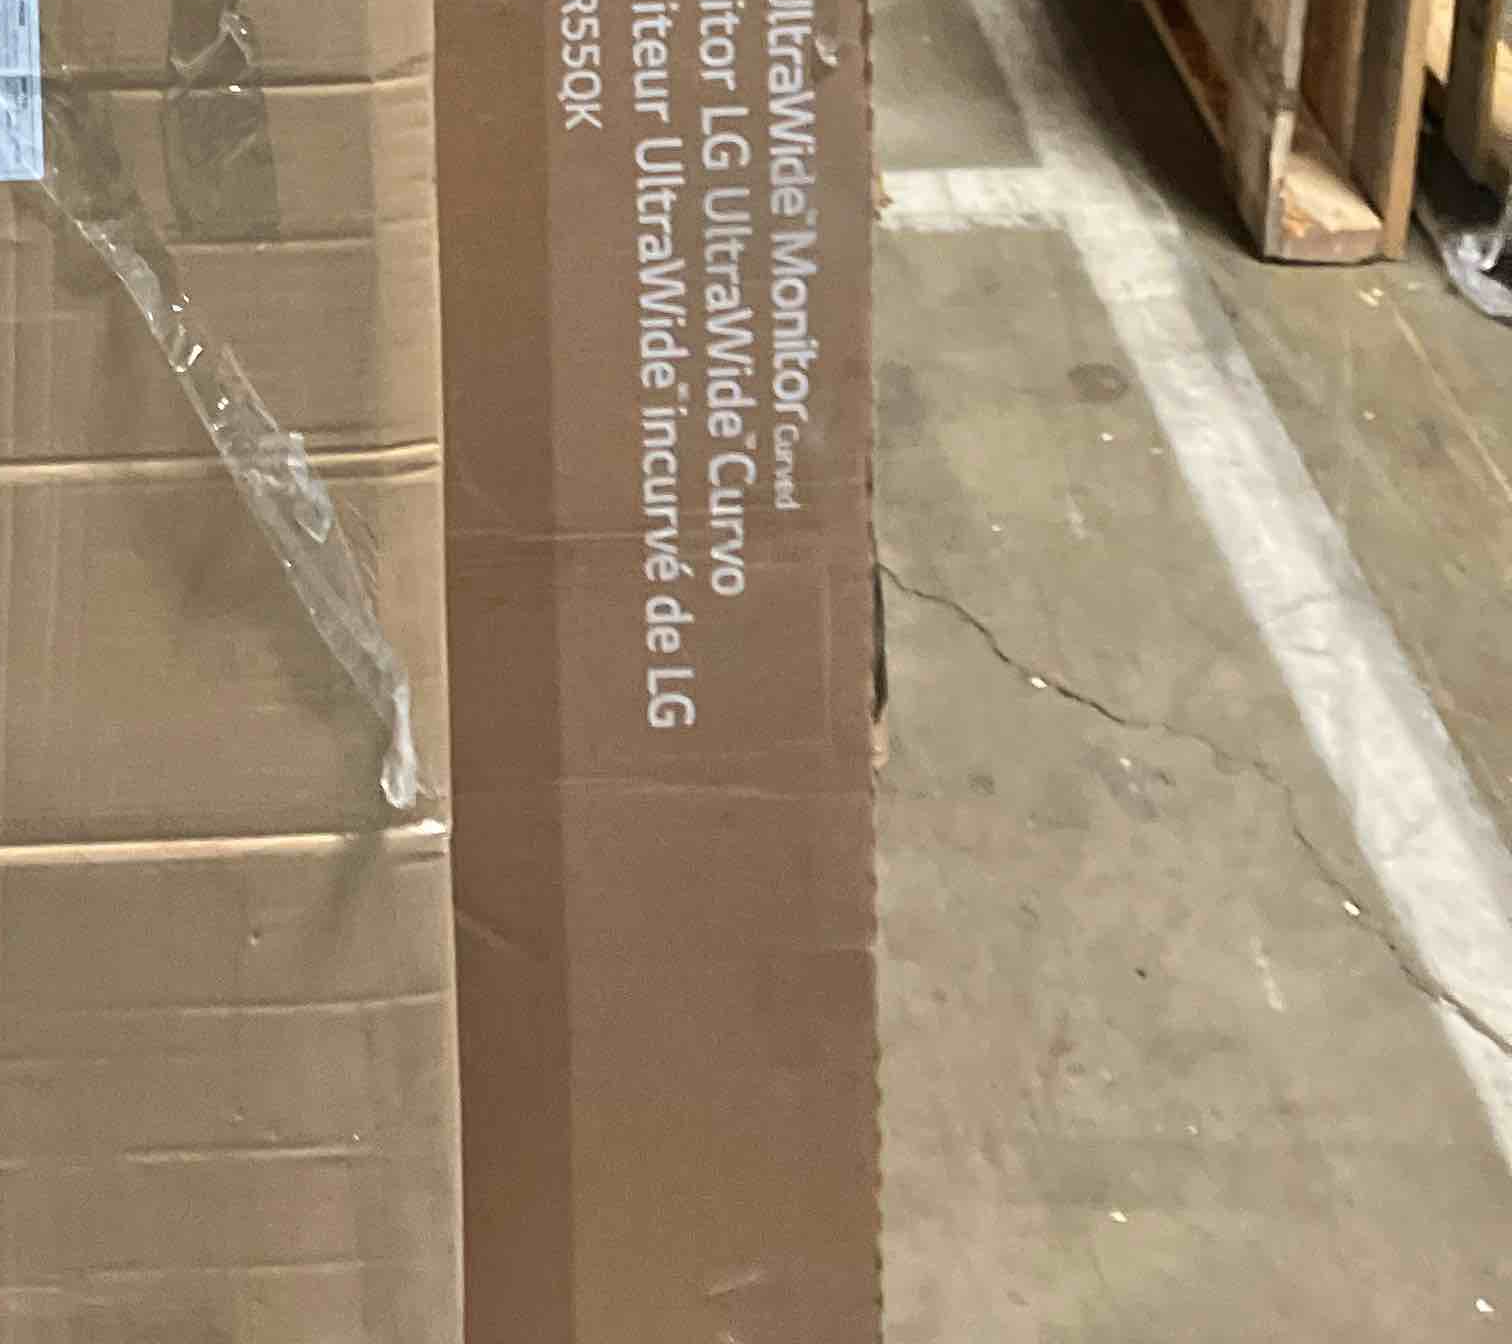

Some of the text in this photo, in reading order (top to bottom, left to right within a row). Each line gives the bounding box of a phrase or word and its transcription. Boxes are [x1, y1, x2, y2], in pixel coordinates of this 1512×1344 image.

[700, 105, 752, 171] LG
[770, 228, 820, 423] Monitor
[641, 405, 695, 582] incurvé
[773, 423, 803, 511] Curved
[707, 451, 756, 596] Curvo
[644, 595, 694, 653] de
[646, 666, 697, 728] LG
